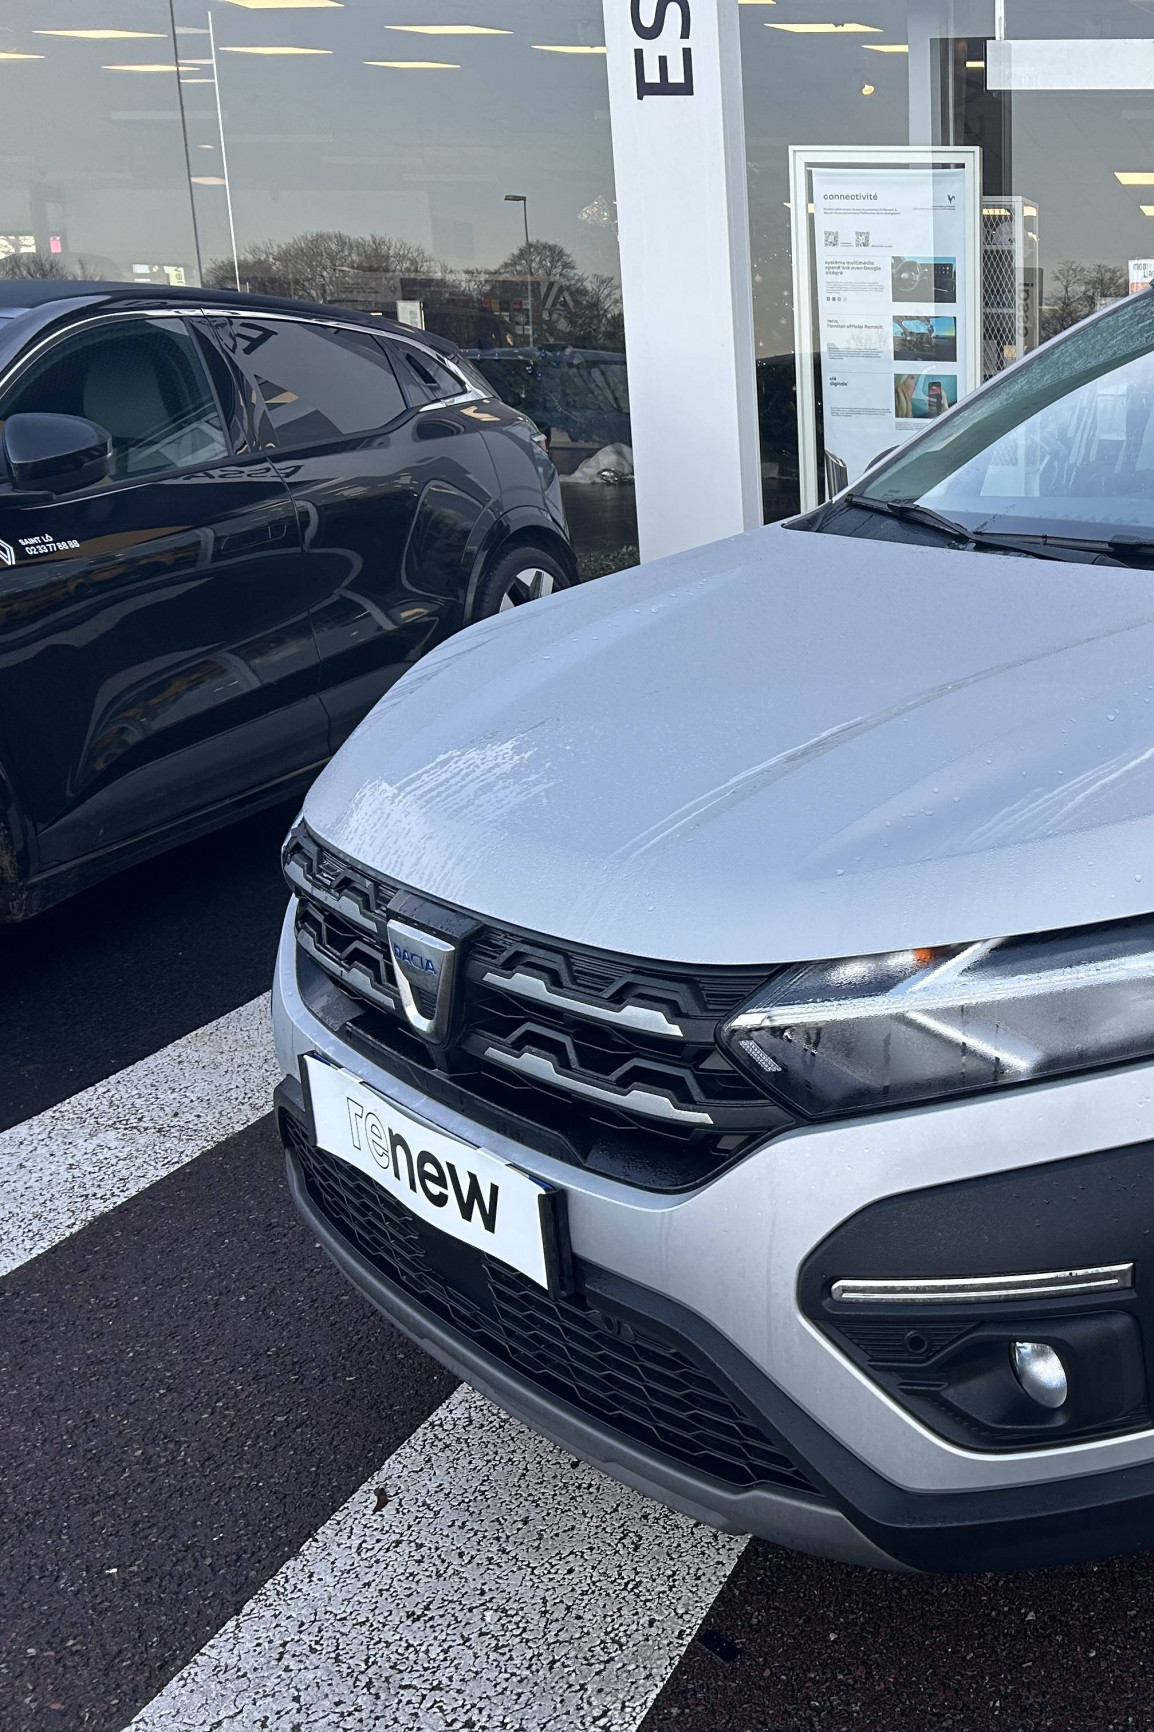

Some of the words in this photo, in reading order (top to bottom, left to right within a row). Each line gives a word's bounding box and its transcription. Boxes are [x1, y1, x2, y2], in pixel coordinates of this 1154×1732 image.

[823, 192, 878, 201] connectivité
[18, 536, 41, 546] SAINT
[393, 943, 437, 975] DACIA
[347, 1097, 499, 1234] renew
